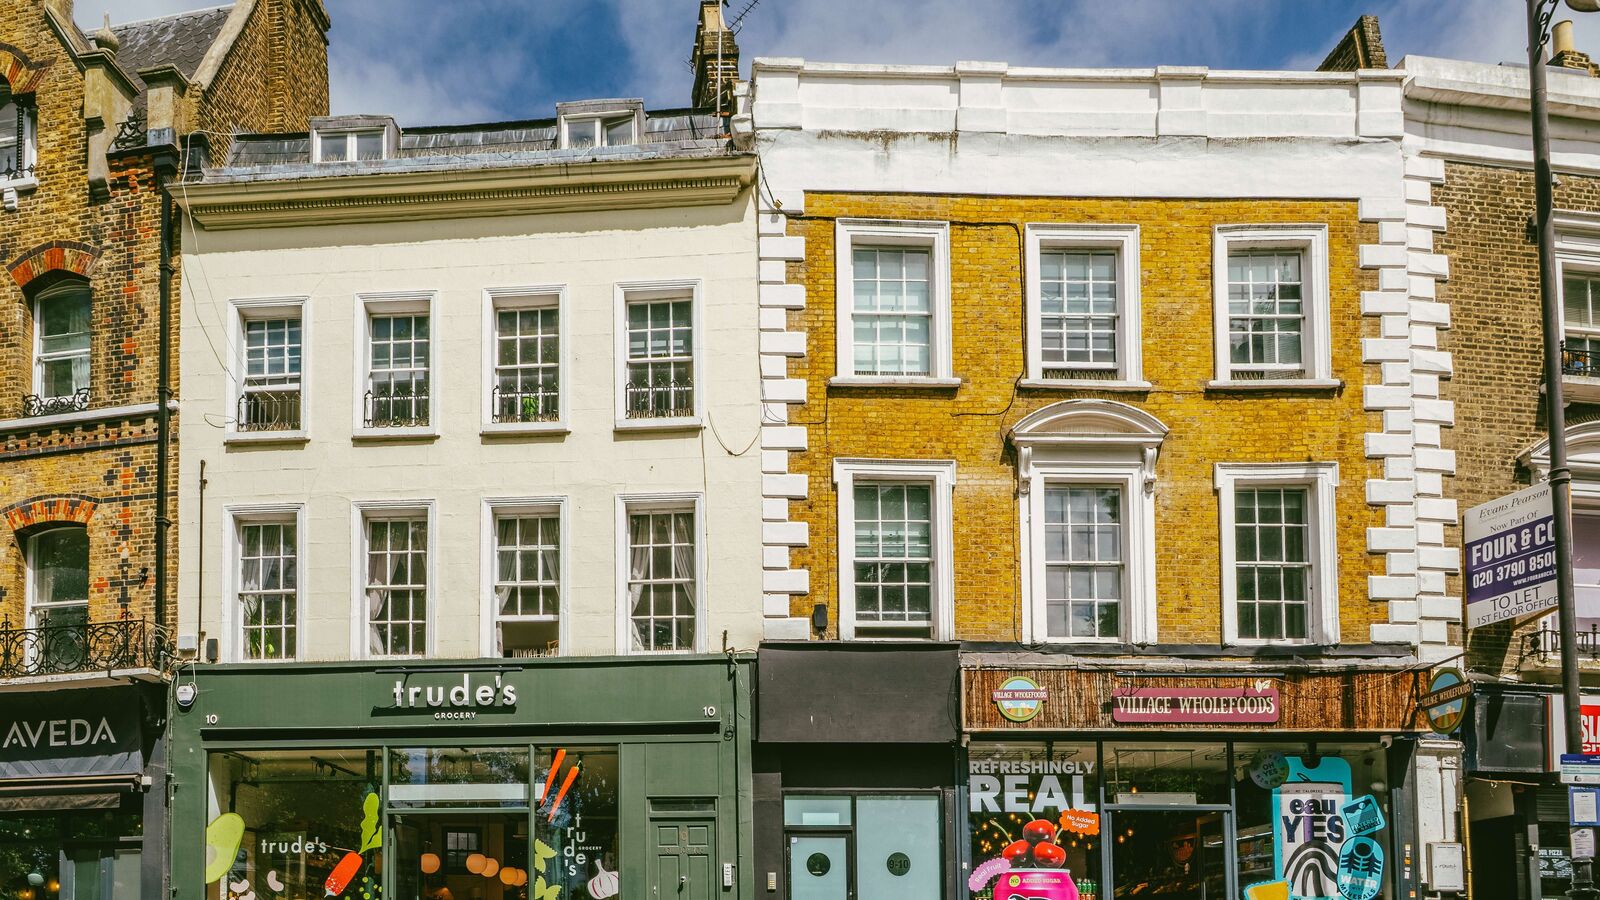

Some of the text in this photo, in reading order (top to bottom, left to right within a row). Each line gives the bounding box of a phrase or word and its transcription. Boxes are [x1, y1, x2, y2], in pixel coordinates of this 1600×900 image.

[1480, 488, 1549, 519] Evans Pearson
[1490, 522, 1508, 533] Now
[1510, 515, 1525, 527] Part
[1527, 510, 1538, 520] Of
[1472, 533, 1518, 566] FOUR
[1521, 528, 1532, 550] &
[1472, 569, 1494, 589] 020
[1496, 560, 1526, 582] 3790
[1490, 586, 1542, 612] TO LET
[1476, 614, 1492, 625] 1ST
[1494, 605, 1524, 619] FLOOR
[393, 673, 517, 707] trude's
[993, 691, 1048, 699] VILLAGE WHOLEFOODS
[703, 706, 716, 717] 10
[1117, 696, 1275, 714] VILLAGE WHOLEFOODS
[205, 714, 218, 724] 10
[434, 711, 477, 720] GROCERY
[3, 716, 117, 749] AVEDA
[1580, 714, 1600, 743] SL
[969, 761, 1095, 774] REFRESHINGLY
[970, 775, 1096, 813] REAL
[1289, 798, 1336, 815] eau
[1071, 820, 1089, 829] Sugar
[1075, 816, 1096, 825] Added
[1282, 815, 1345, 843] YES
[261, 835, 327, 854] trude's
[1341, 875, 1377, 888] WATER
[1340, 883, 1376, 900] MINERALS
